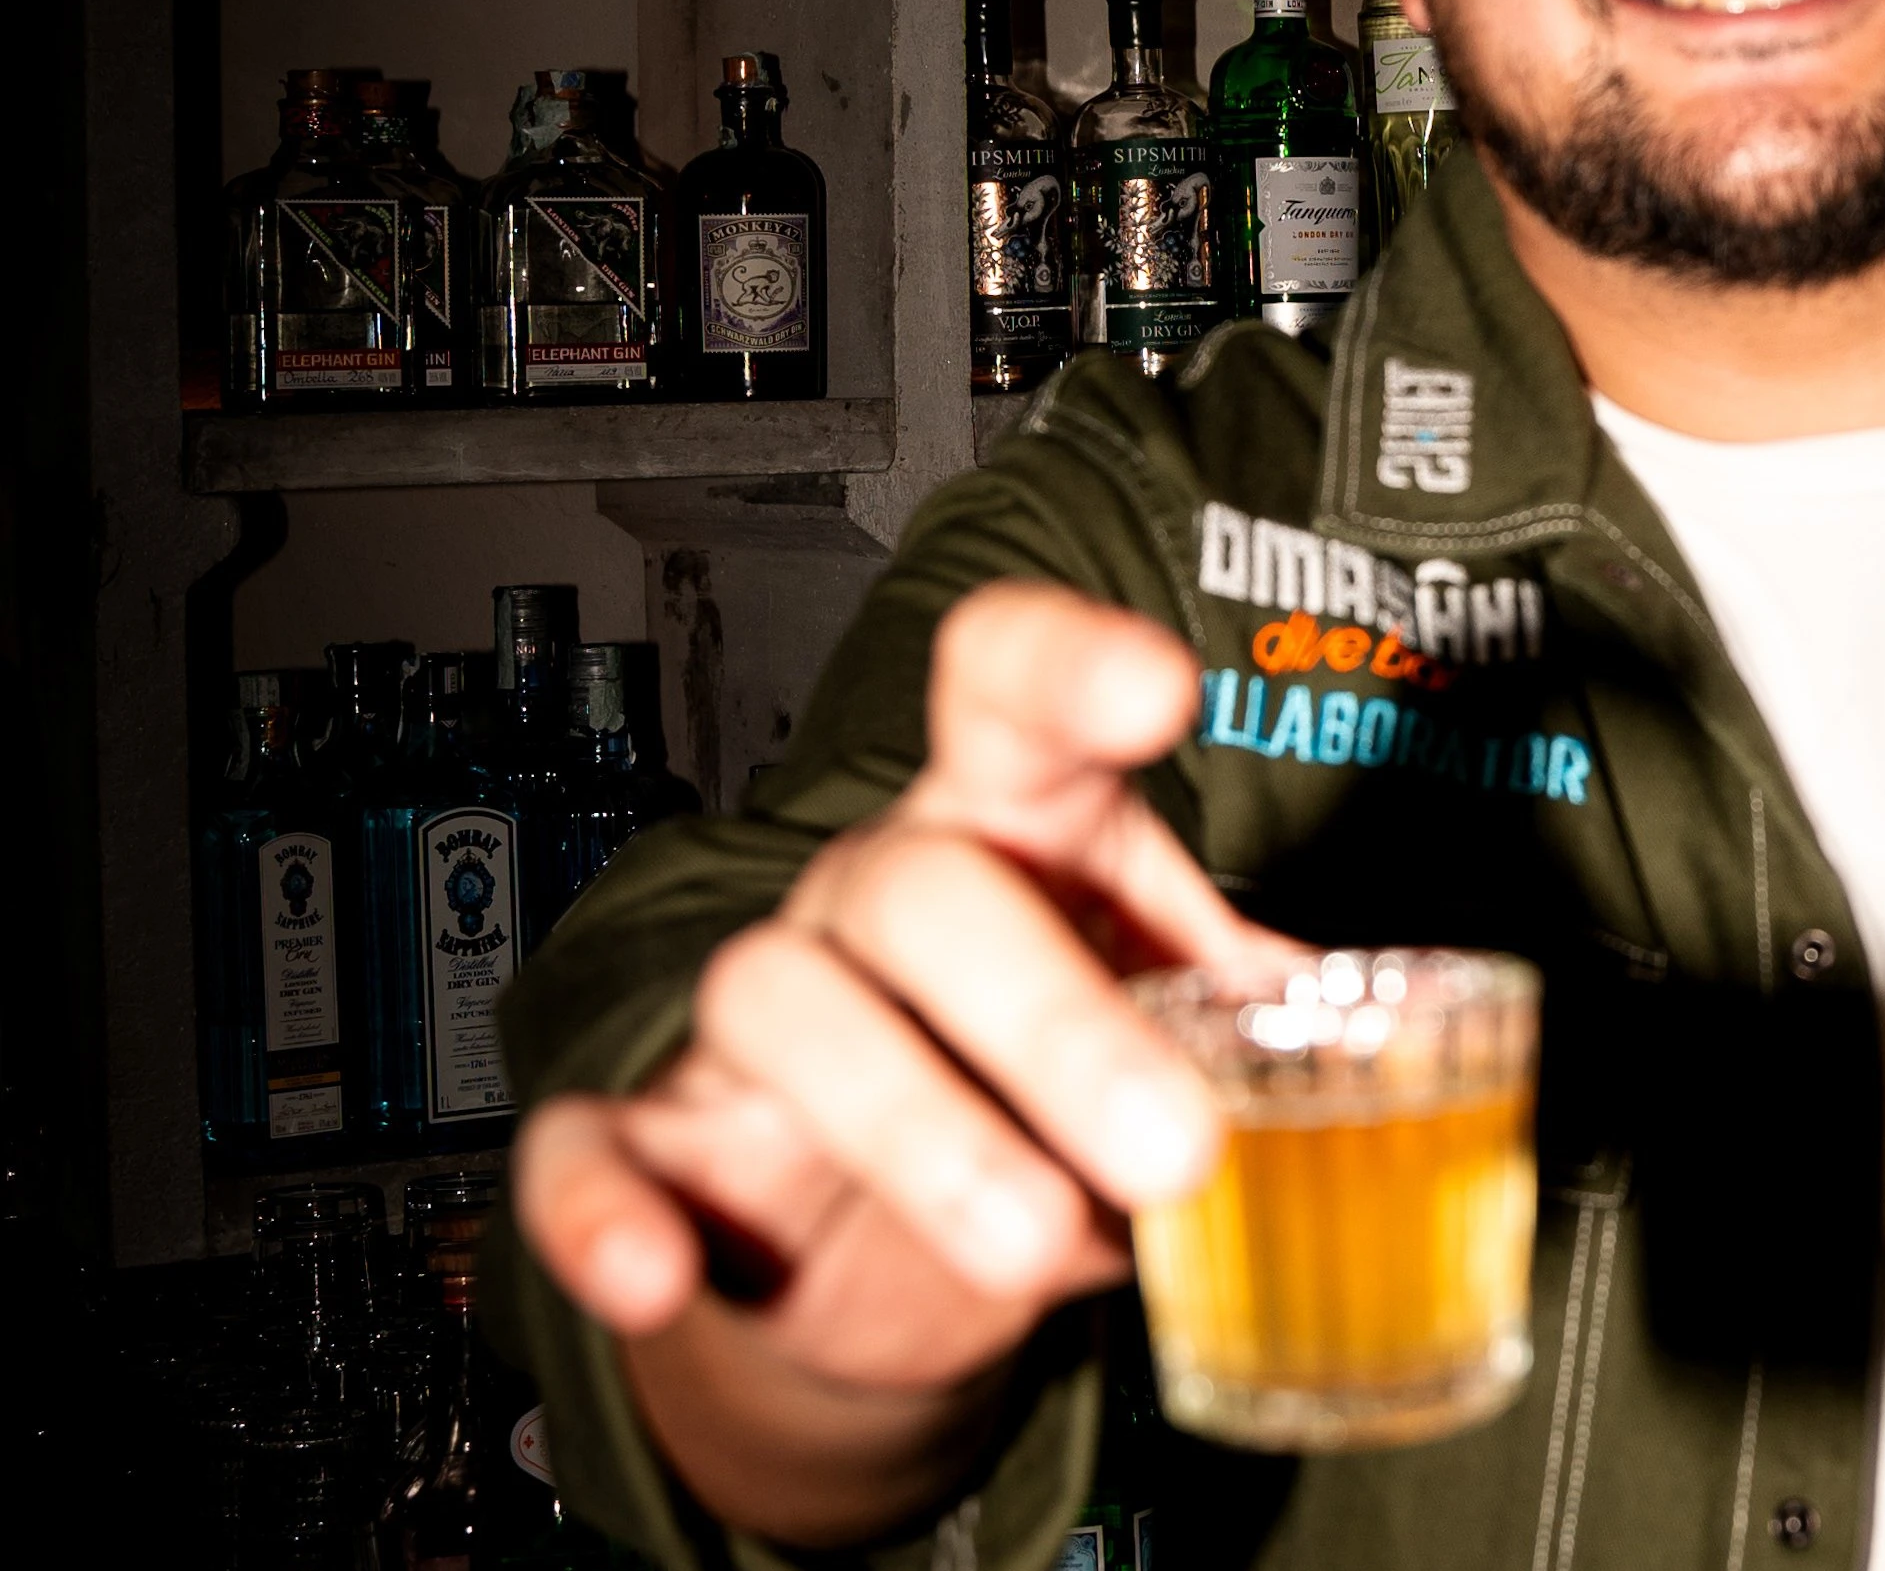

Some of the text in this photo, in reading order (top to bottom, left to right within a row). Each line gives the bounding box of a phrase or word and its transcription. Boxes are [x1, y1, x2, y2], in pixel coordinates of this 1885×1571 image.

[1114, 146, 1207, 164] SIPSMITH
[1148, 164, 1187, 178] London
[711, 220, 799, 241] MONKEY 47
[1153, 309, 1192, 323] London
[710, 324, 774, 346] SCHWARZWALD
[1142, 325, 1174, 338] DRY
[281, 353, 396, 368] ELEPHANT GIN
[532, 346, 641, 361] ELEPHANT GIN
[435, 829, 502, 863] BOMBAY
[275, 845, 318, 867] BOMBAY
[275, 907, 323, 929] SAPPHIRE
[274, 935, 323, 950] PREMIER
[435, 923, 507, 957] SAPPHIRE
[447, 956, 499, 972] Distilled
[453, 969, 494, 979] LONDON
[447, 976, 500, 990] DRY GIN
[450, 1010, 496, 1020] INFUSE
